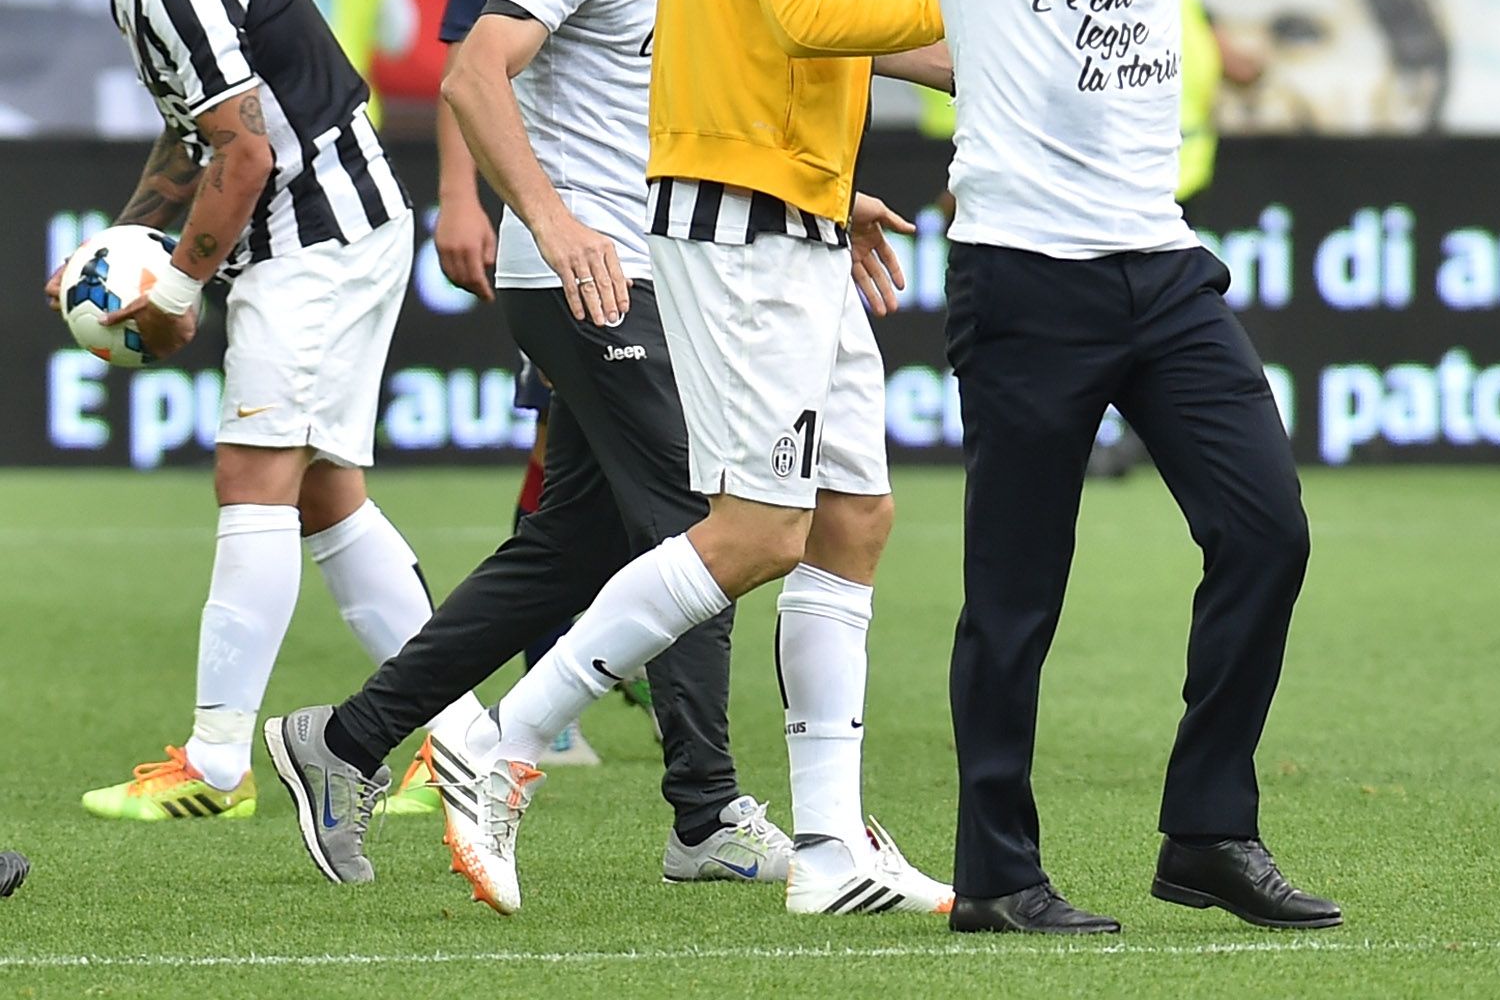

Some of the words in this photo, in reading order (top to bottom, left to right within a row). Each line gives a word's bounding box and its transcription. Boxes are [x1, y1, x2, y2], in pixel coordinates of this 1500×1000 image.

[1076, 14, 1149, 60] legge
[1078, 56, 1111, 92] la
[1314, 204, 1414, 311] di
[603, 345, 647, 362] Jeep
[48, 350, 109, 449] E
[793, 409, 824, 479] 1
